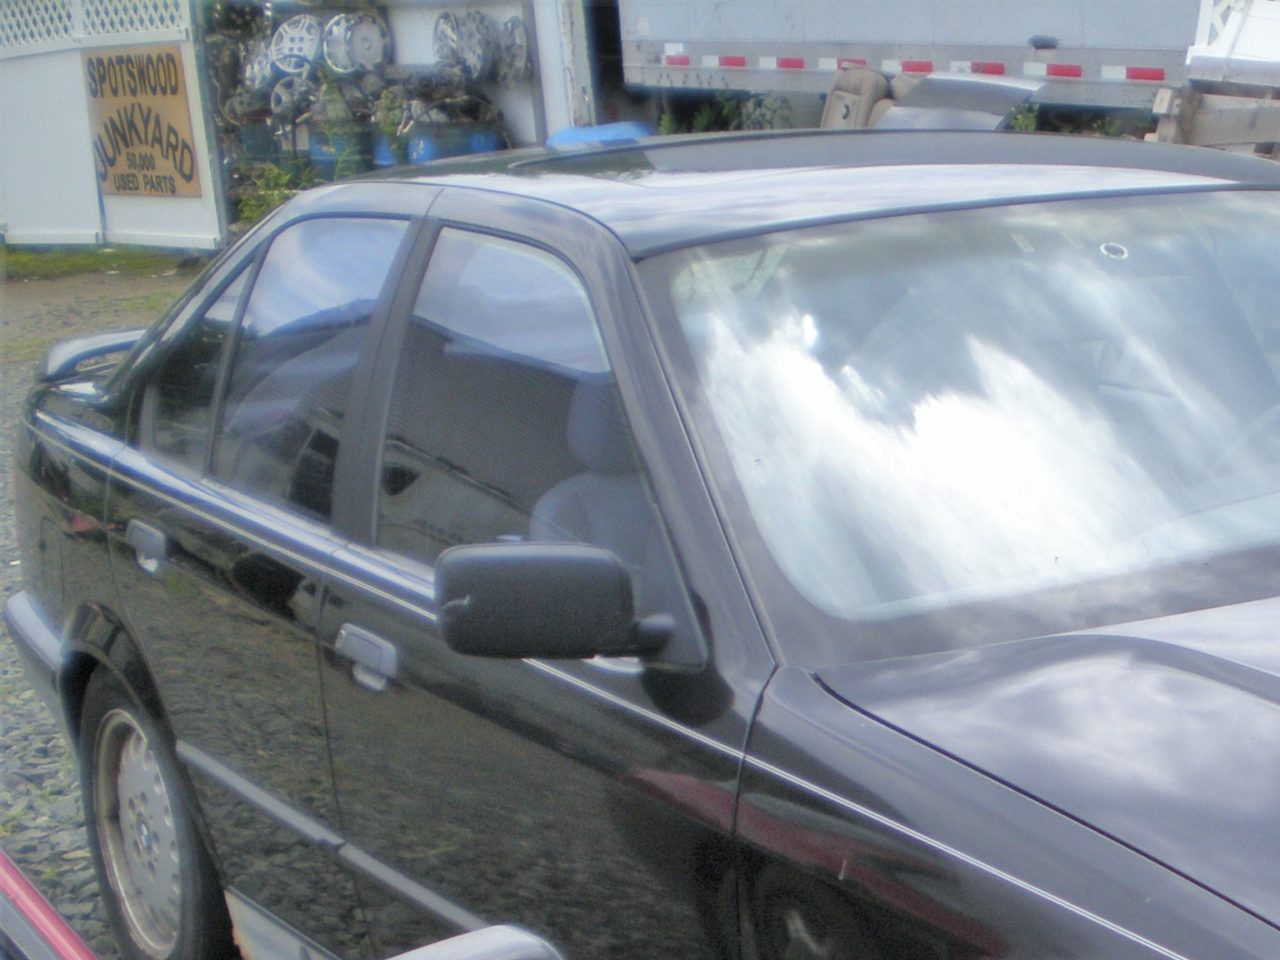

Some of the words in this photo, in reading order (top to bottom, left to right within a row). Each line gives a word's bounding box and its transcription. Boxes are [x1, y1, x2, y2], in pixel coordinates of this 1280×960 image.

[87, 53, 178, 98] SPOTSWOOD
[94, 102, 194, 182] JUNKYARD
[126, 152, 156, 171] 50,000
[113, 173, 139, 191] USED
[142, 175, 176, 194] PARTS
